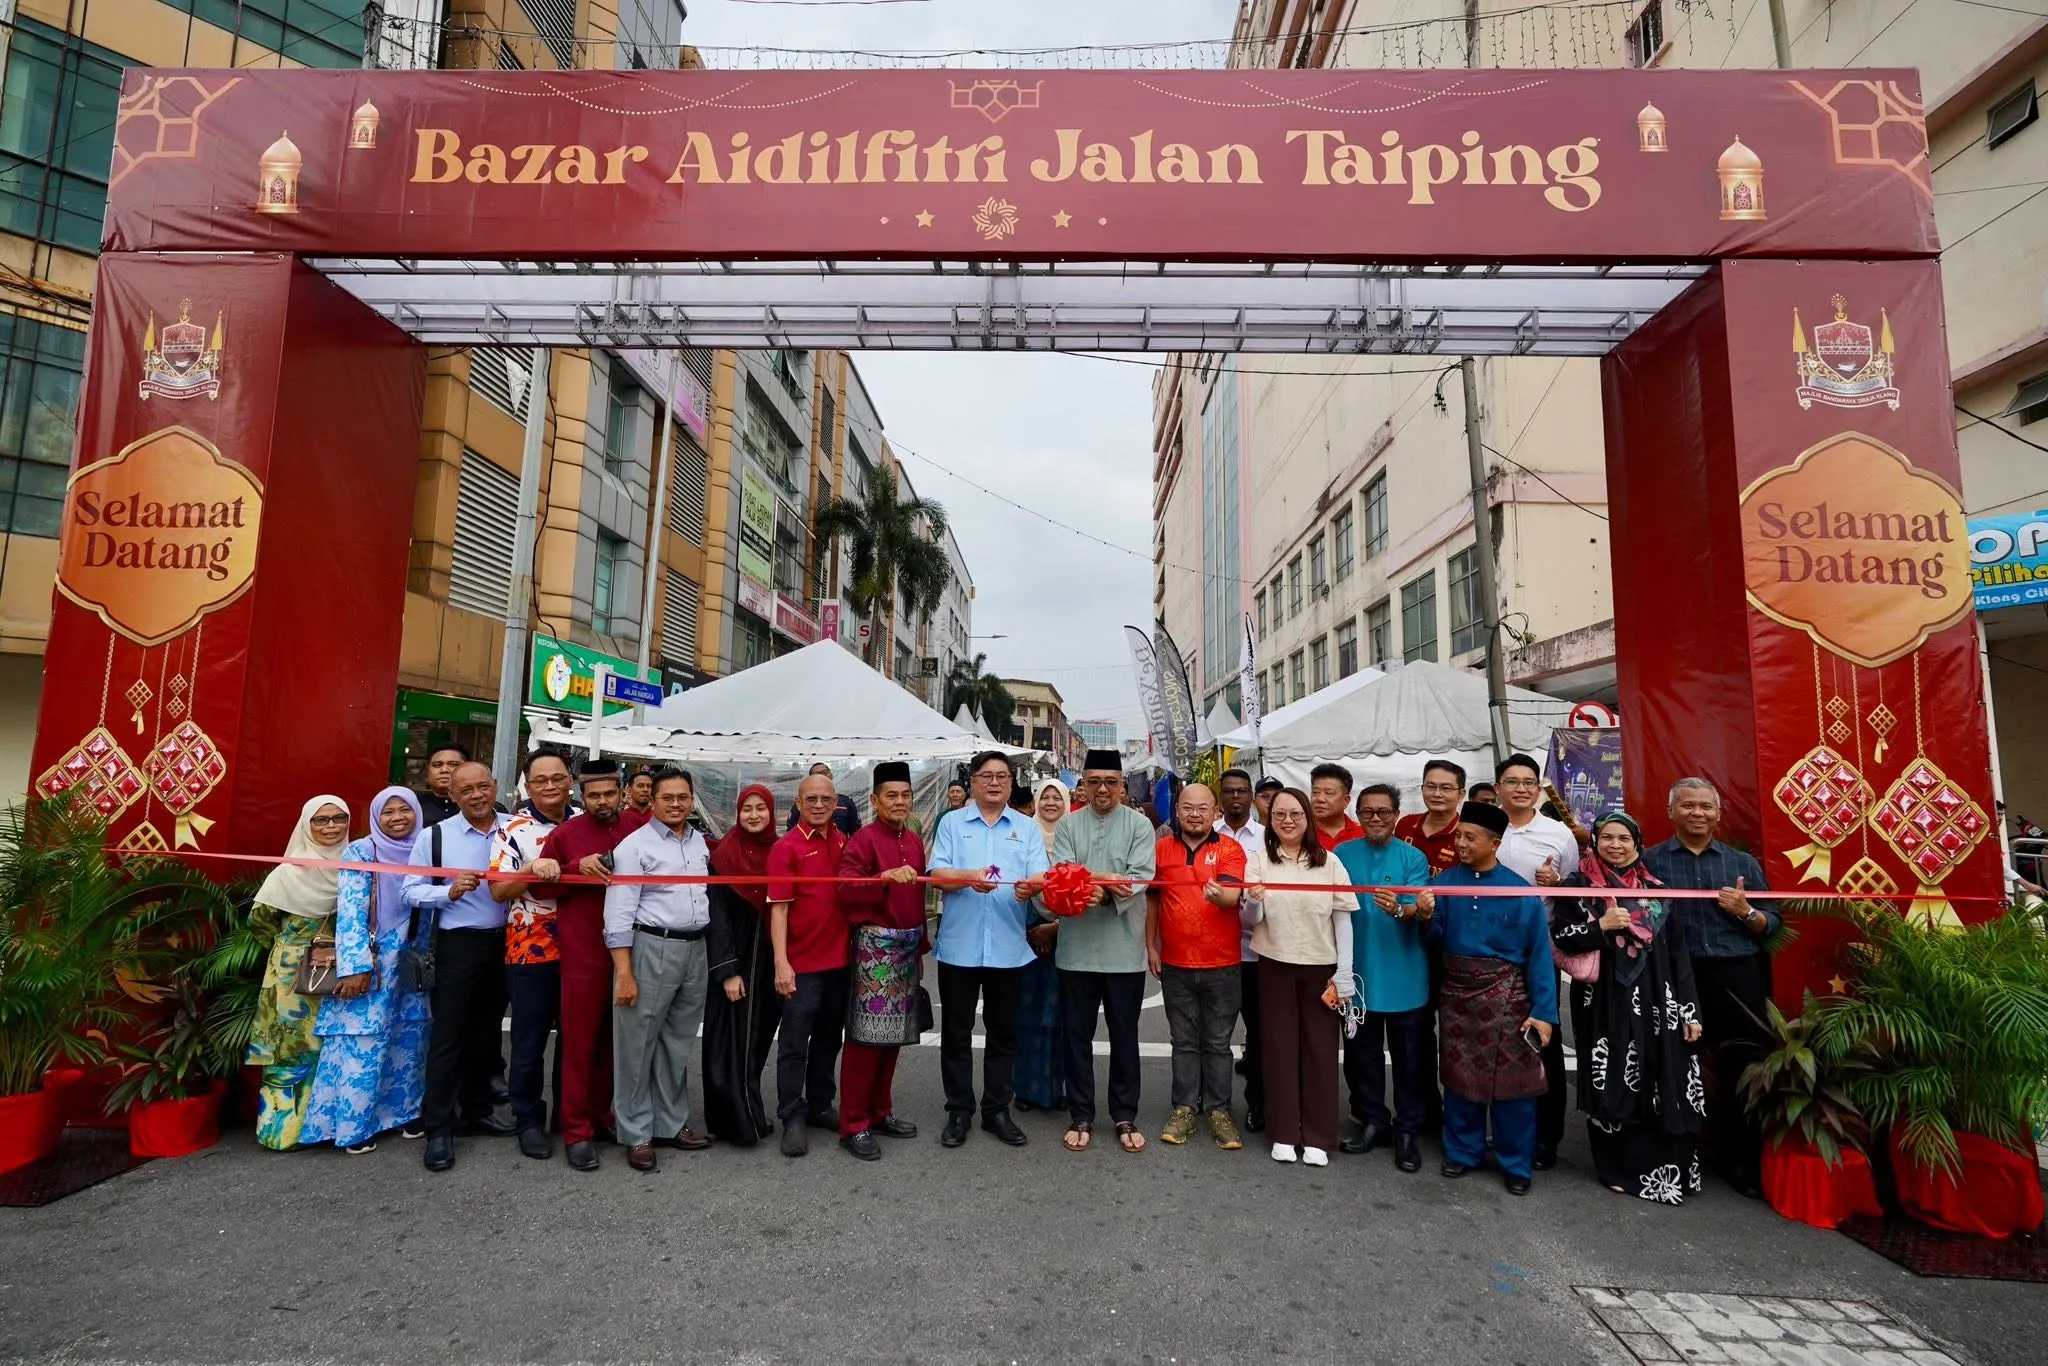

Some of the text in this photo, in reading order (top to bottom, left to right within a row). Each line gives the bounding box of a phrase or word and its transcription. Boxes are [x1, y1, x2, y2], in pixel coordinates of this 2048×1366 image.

[413, 129, 1601, 211] Bazar Aidilfitri Jalan Taiping
[1800, 391, 1897, 404] MAJLIS BANDARAYA DIRAJA KLANG
[75, 491, 245, 528] Selamat
[1757, 501, 1954, 543] Selamat
[82, 531, 233, 581] Datang
[1774, 545, 1948, 599] Datang
[1975, 593, 2021, 605] Klang
[623, 687, 637, 697] JALAN
